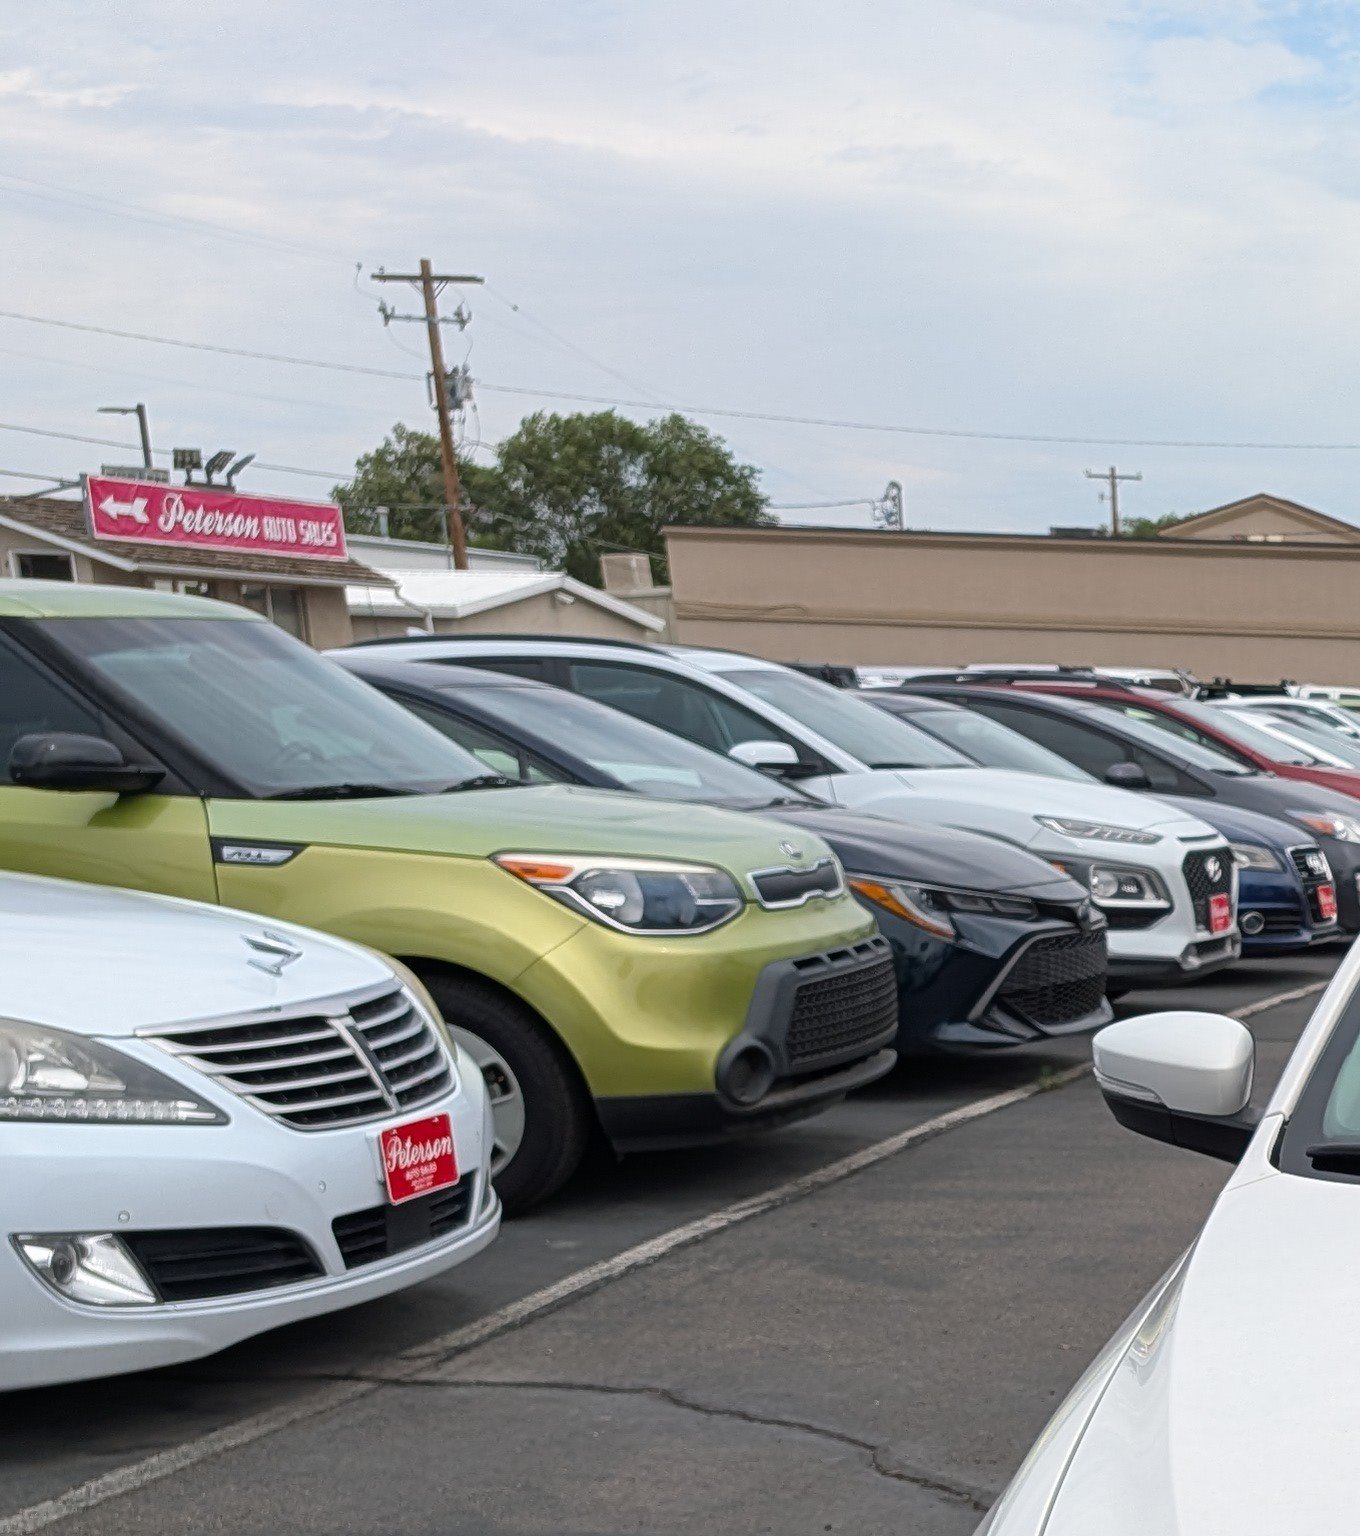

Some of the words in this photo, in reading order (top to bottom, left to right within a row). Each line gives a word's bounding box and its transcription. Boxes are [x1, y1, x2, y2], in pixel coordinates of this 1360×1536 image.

[158, 493, 262, 540] Peterson
[262, 516, 297, 544] AUTO
[299, 518, 337, 547] SALES
[386, 1135, 453, 1173] Peterson
